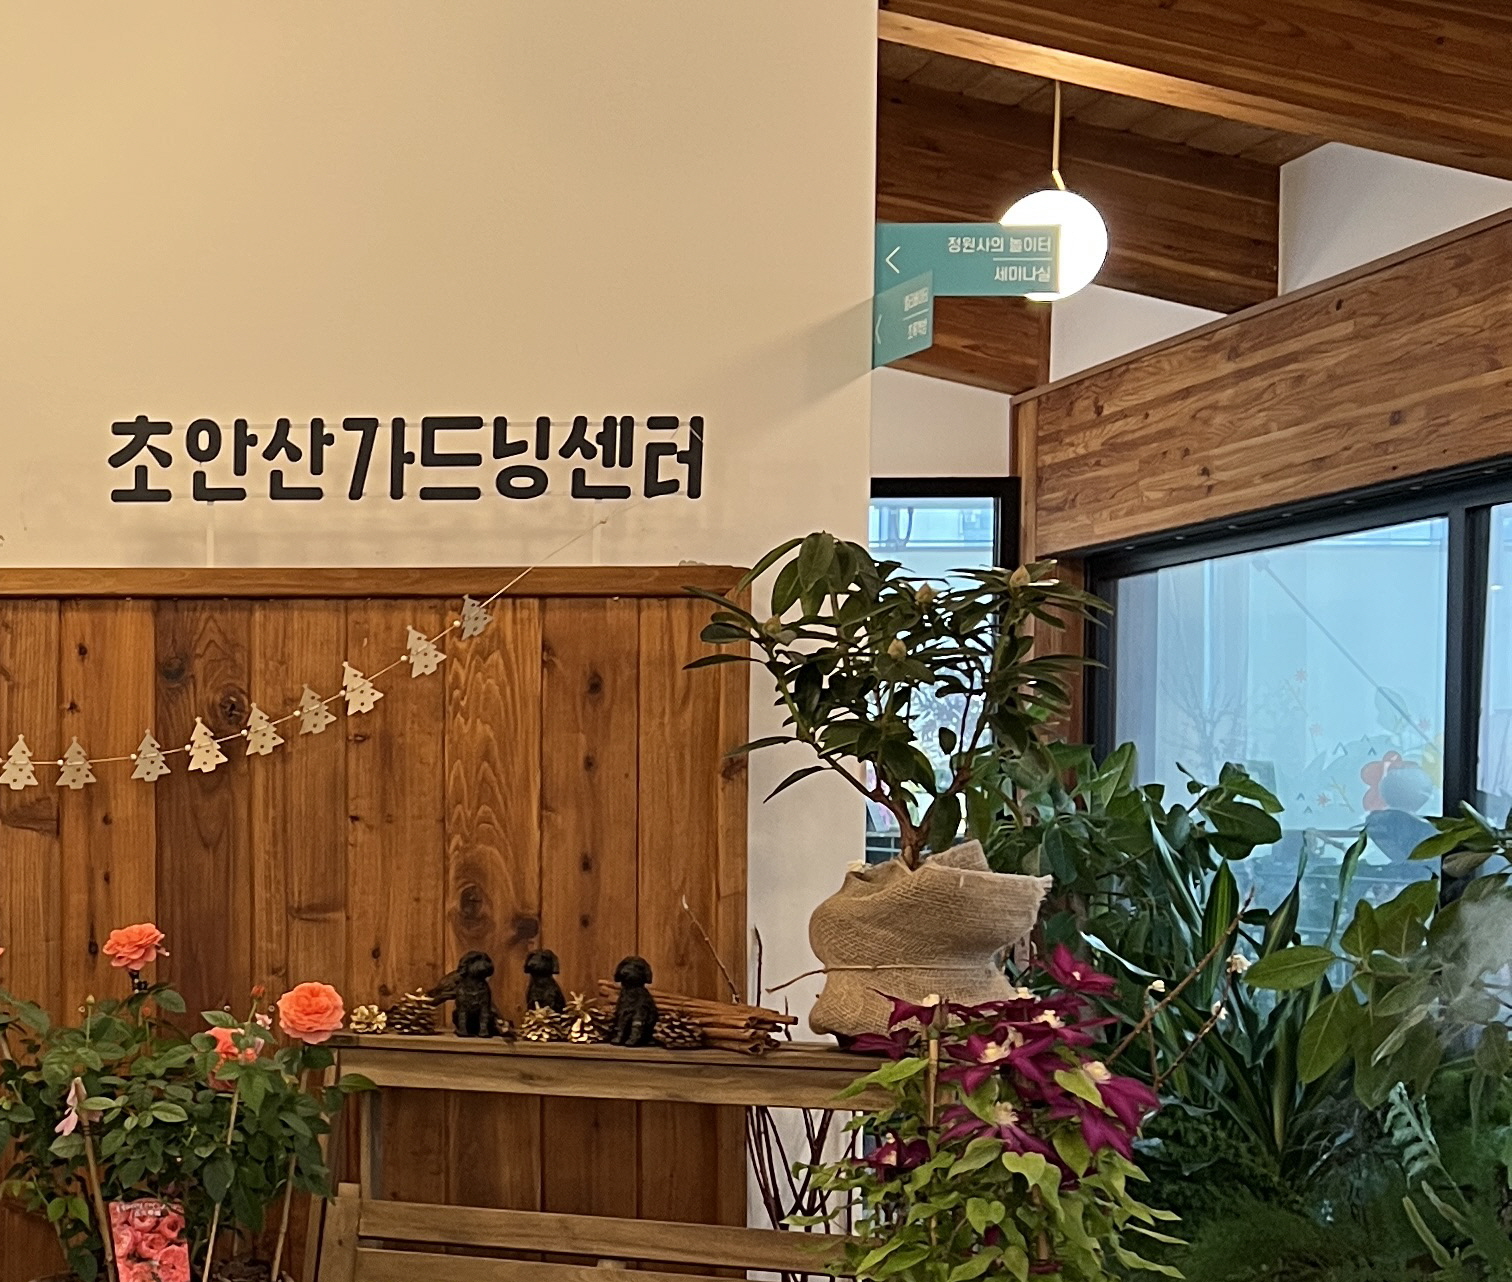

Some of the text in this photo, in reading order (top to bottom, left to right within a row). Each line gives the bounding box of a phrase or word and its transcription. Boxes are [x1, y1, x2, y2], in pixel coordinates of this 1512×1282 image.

[948, 236, 1052, 253] 정원사의 놀이터
[994, 266, 1051, 283] 세미나실
[108, 415, 704, 502] 초안산가드닝센터
